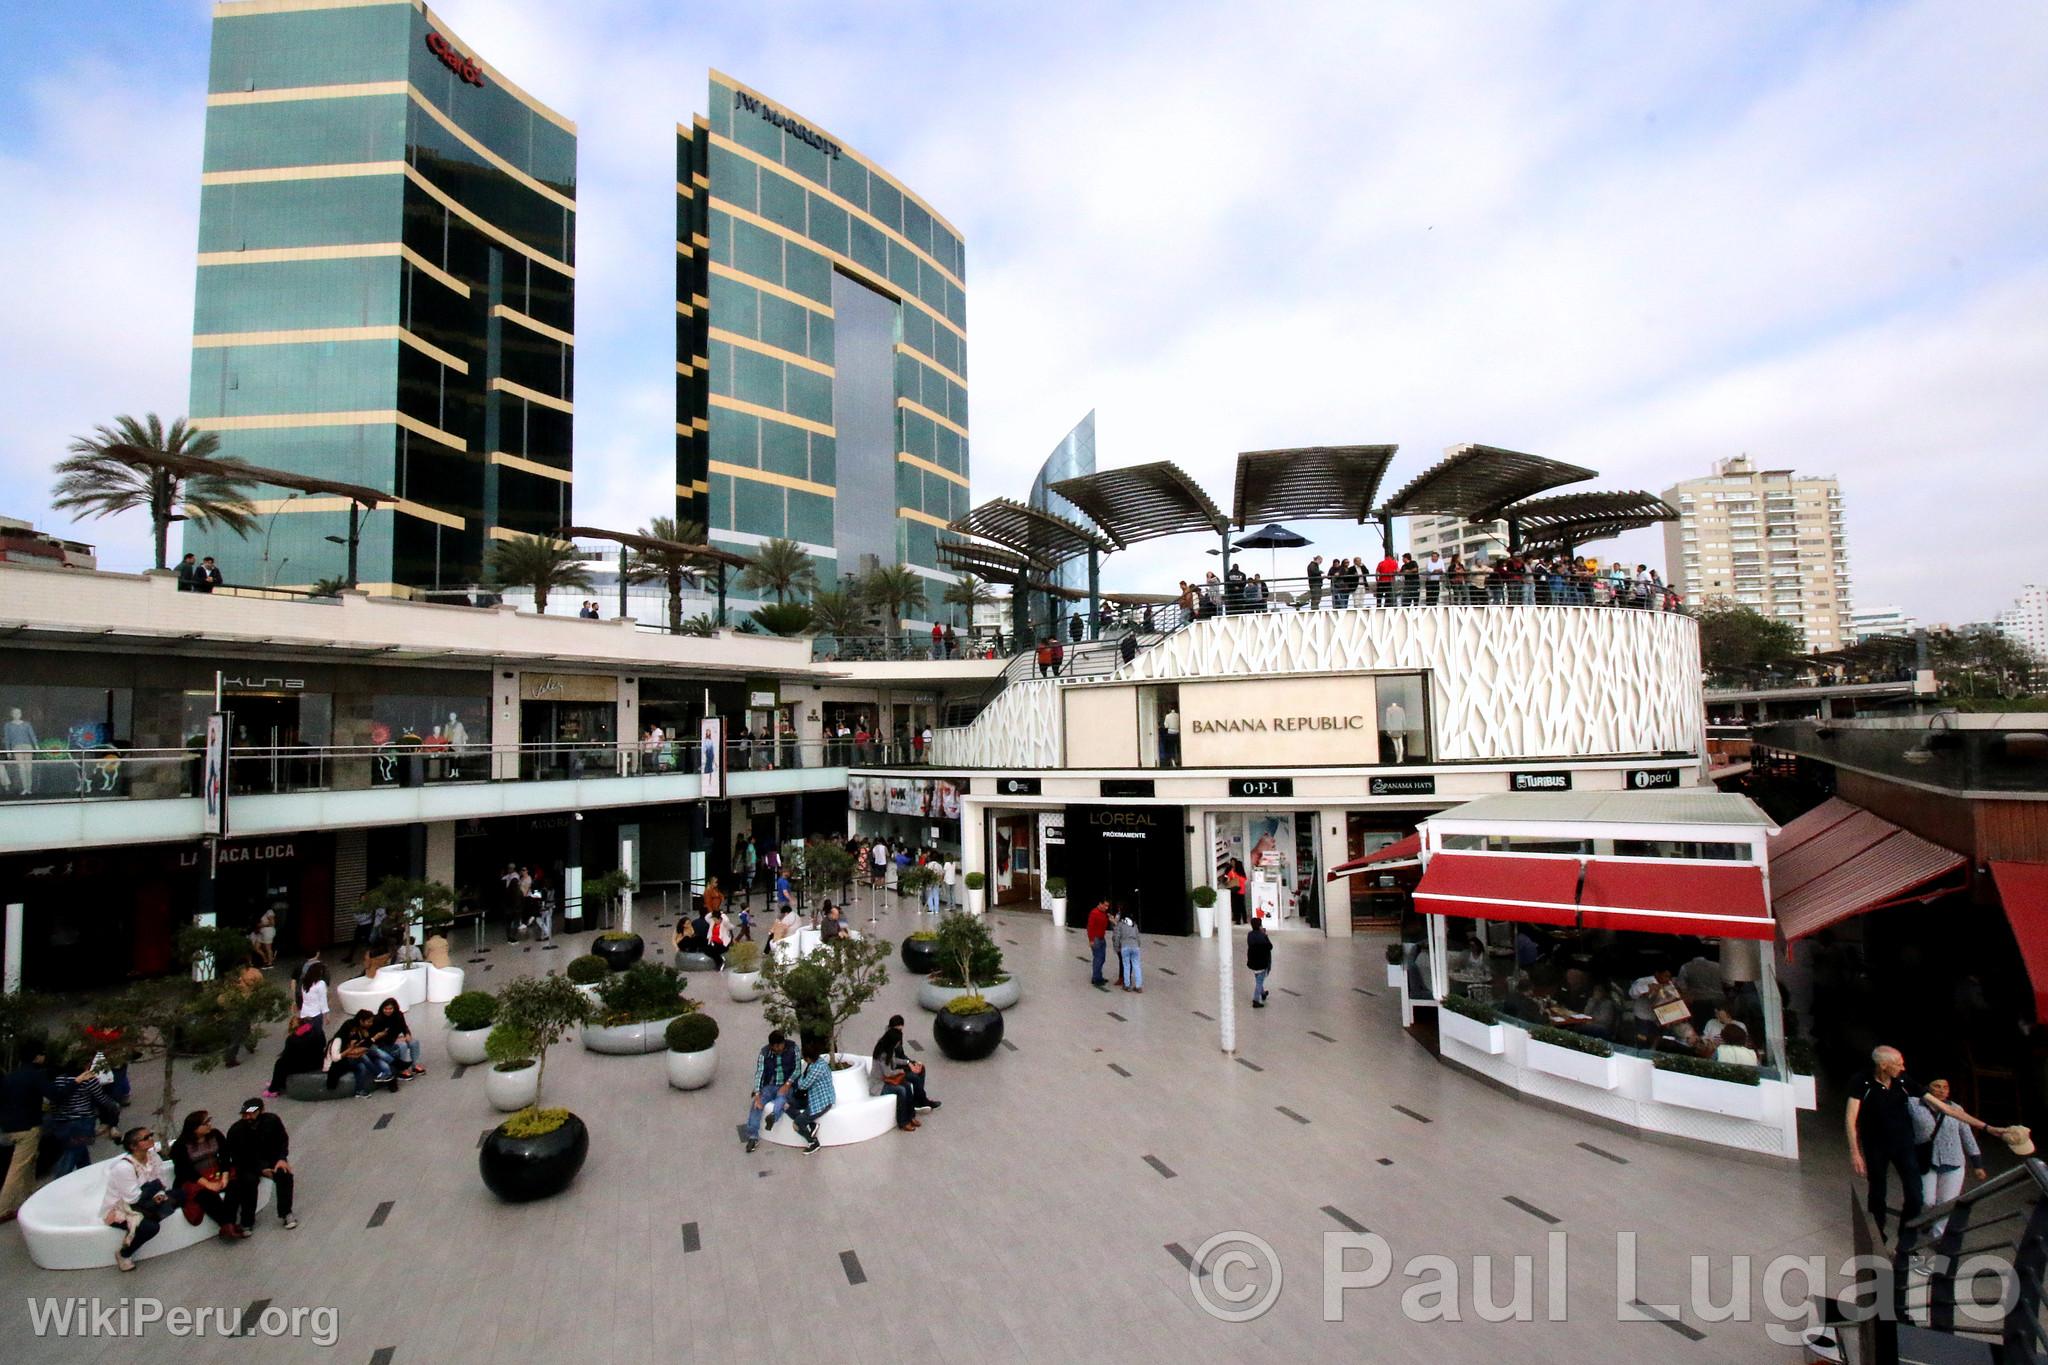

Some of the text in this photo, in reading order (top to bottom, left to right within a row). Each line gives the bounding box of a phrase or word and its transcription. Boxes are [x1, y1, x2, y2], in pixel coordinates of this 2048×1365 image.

[425, 31, 485, 87] Claro
[735, 90, 842, 160] JW MARRIOTT
[1192, 715, 1364, 734] BANANA REPUBLIC
[1414, 781, 1433, 789] HATS
[254, 844, 295, 860] LOCA
